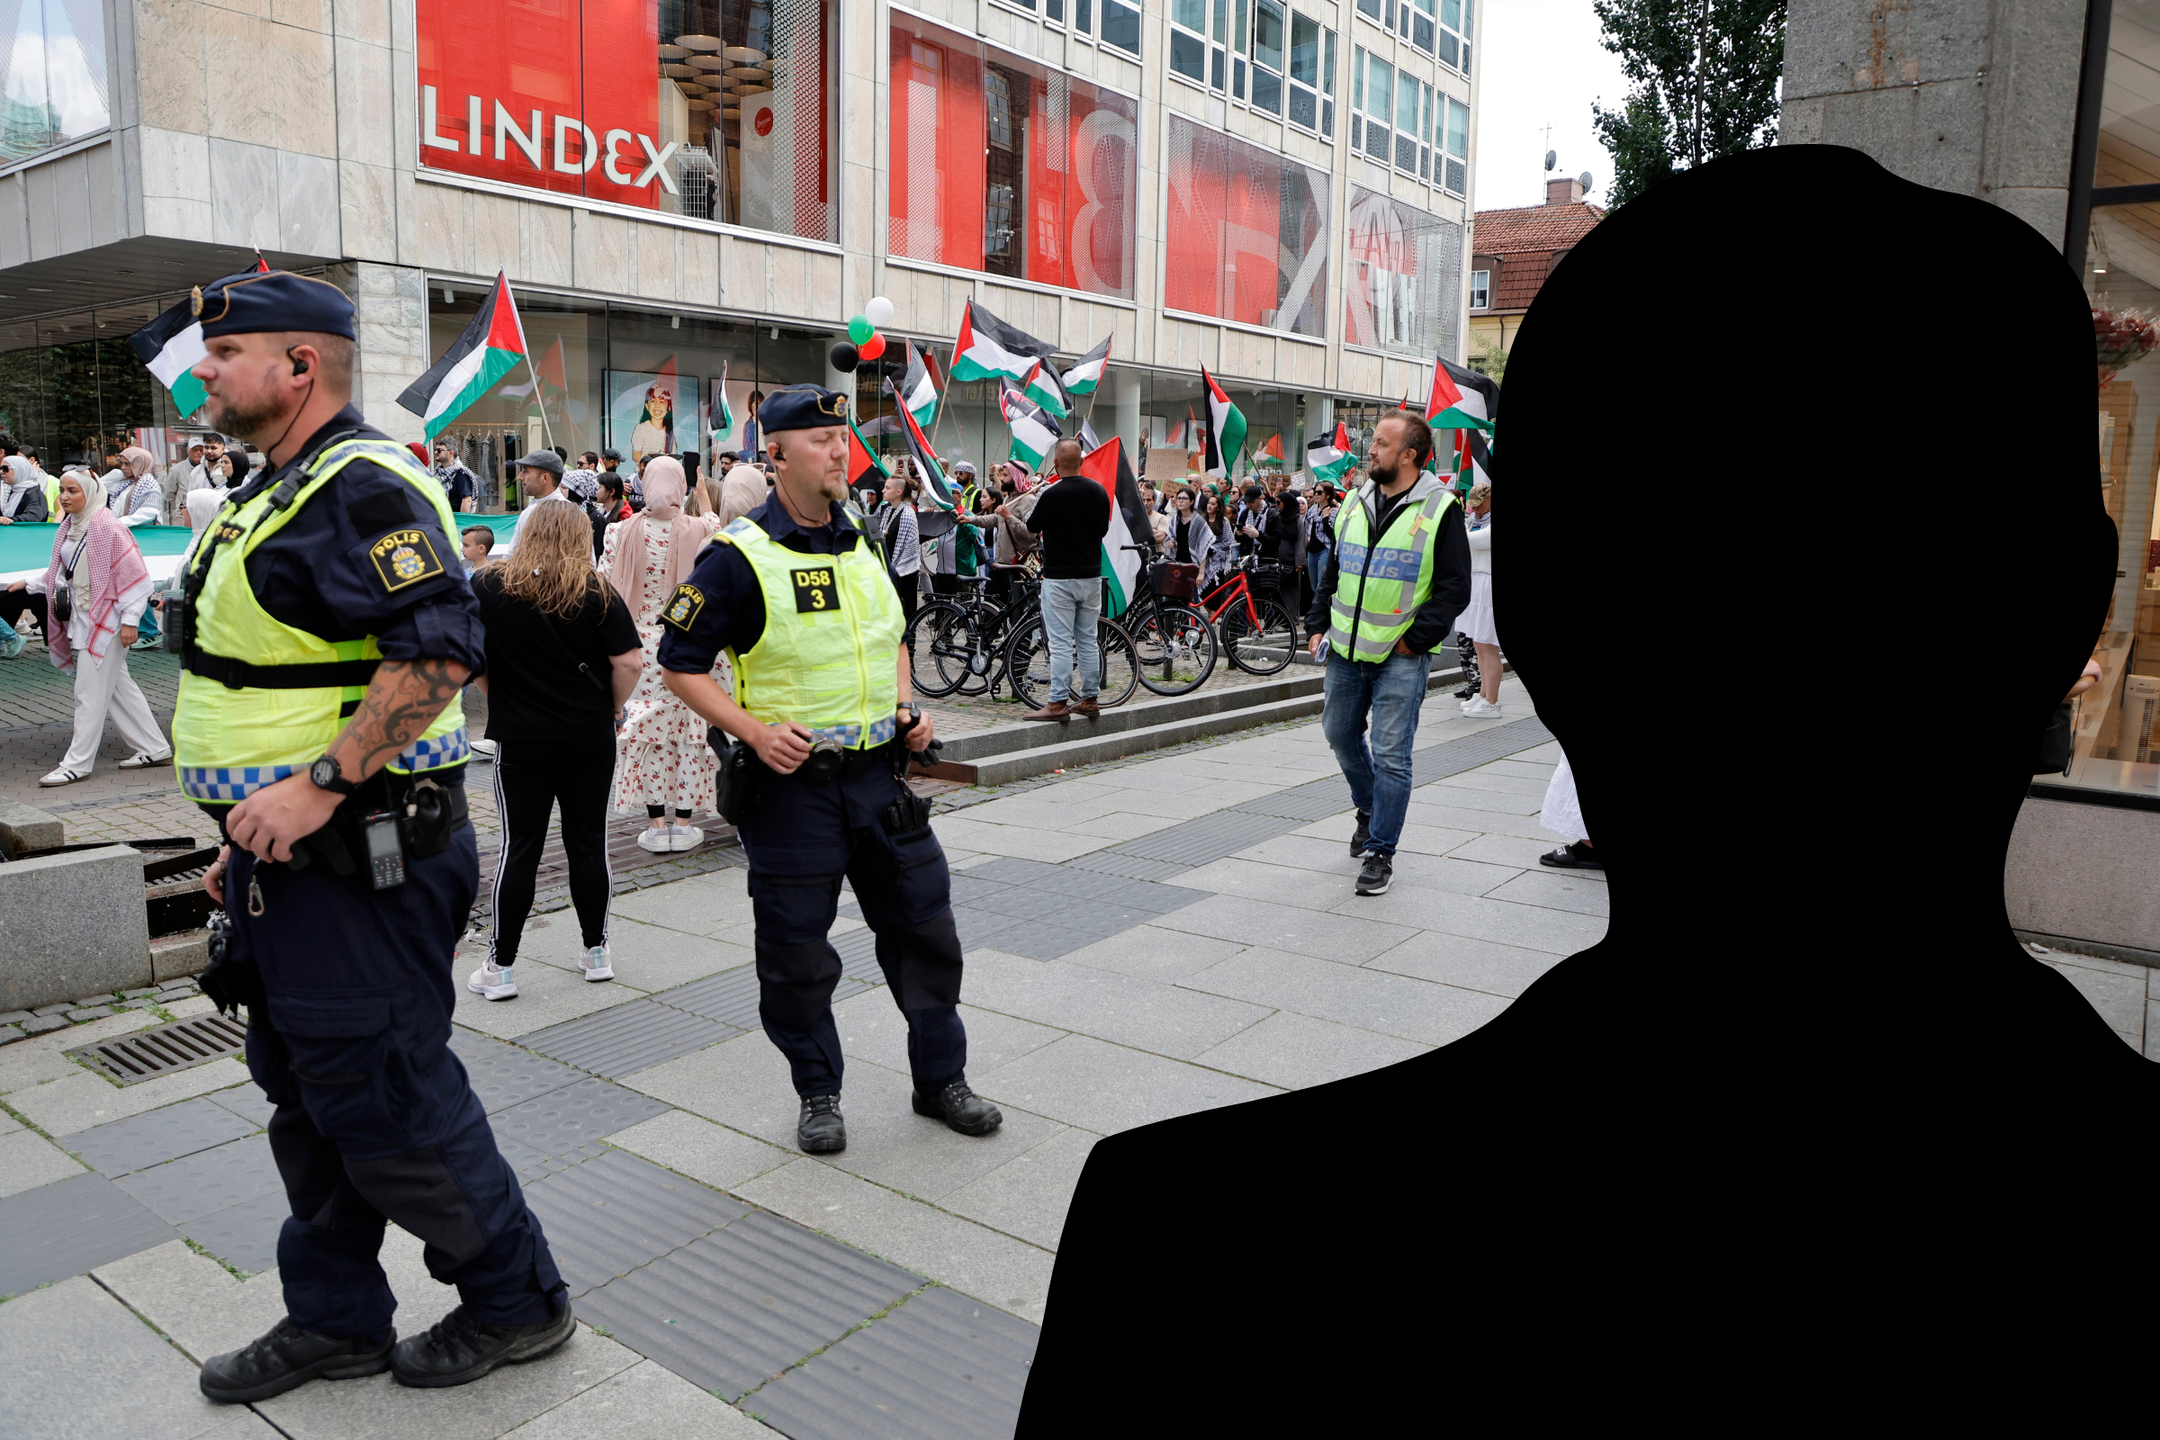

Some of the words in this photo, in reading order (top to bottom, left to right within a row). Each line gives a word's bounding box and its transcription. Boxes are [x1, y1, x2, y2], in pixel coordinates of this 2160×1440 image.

[421, 84, 679, 195] LINDEX
[374, 532, 420, 558] POLIS
[1341, 544, 1415, 564] DIALOG
[795, 570, 832, 588] D58
[1342, 560, 1400, 578] POLIS
[678, 585, 703, 605] POLIS
[809, 589, 827, 610] 3
